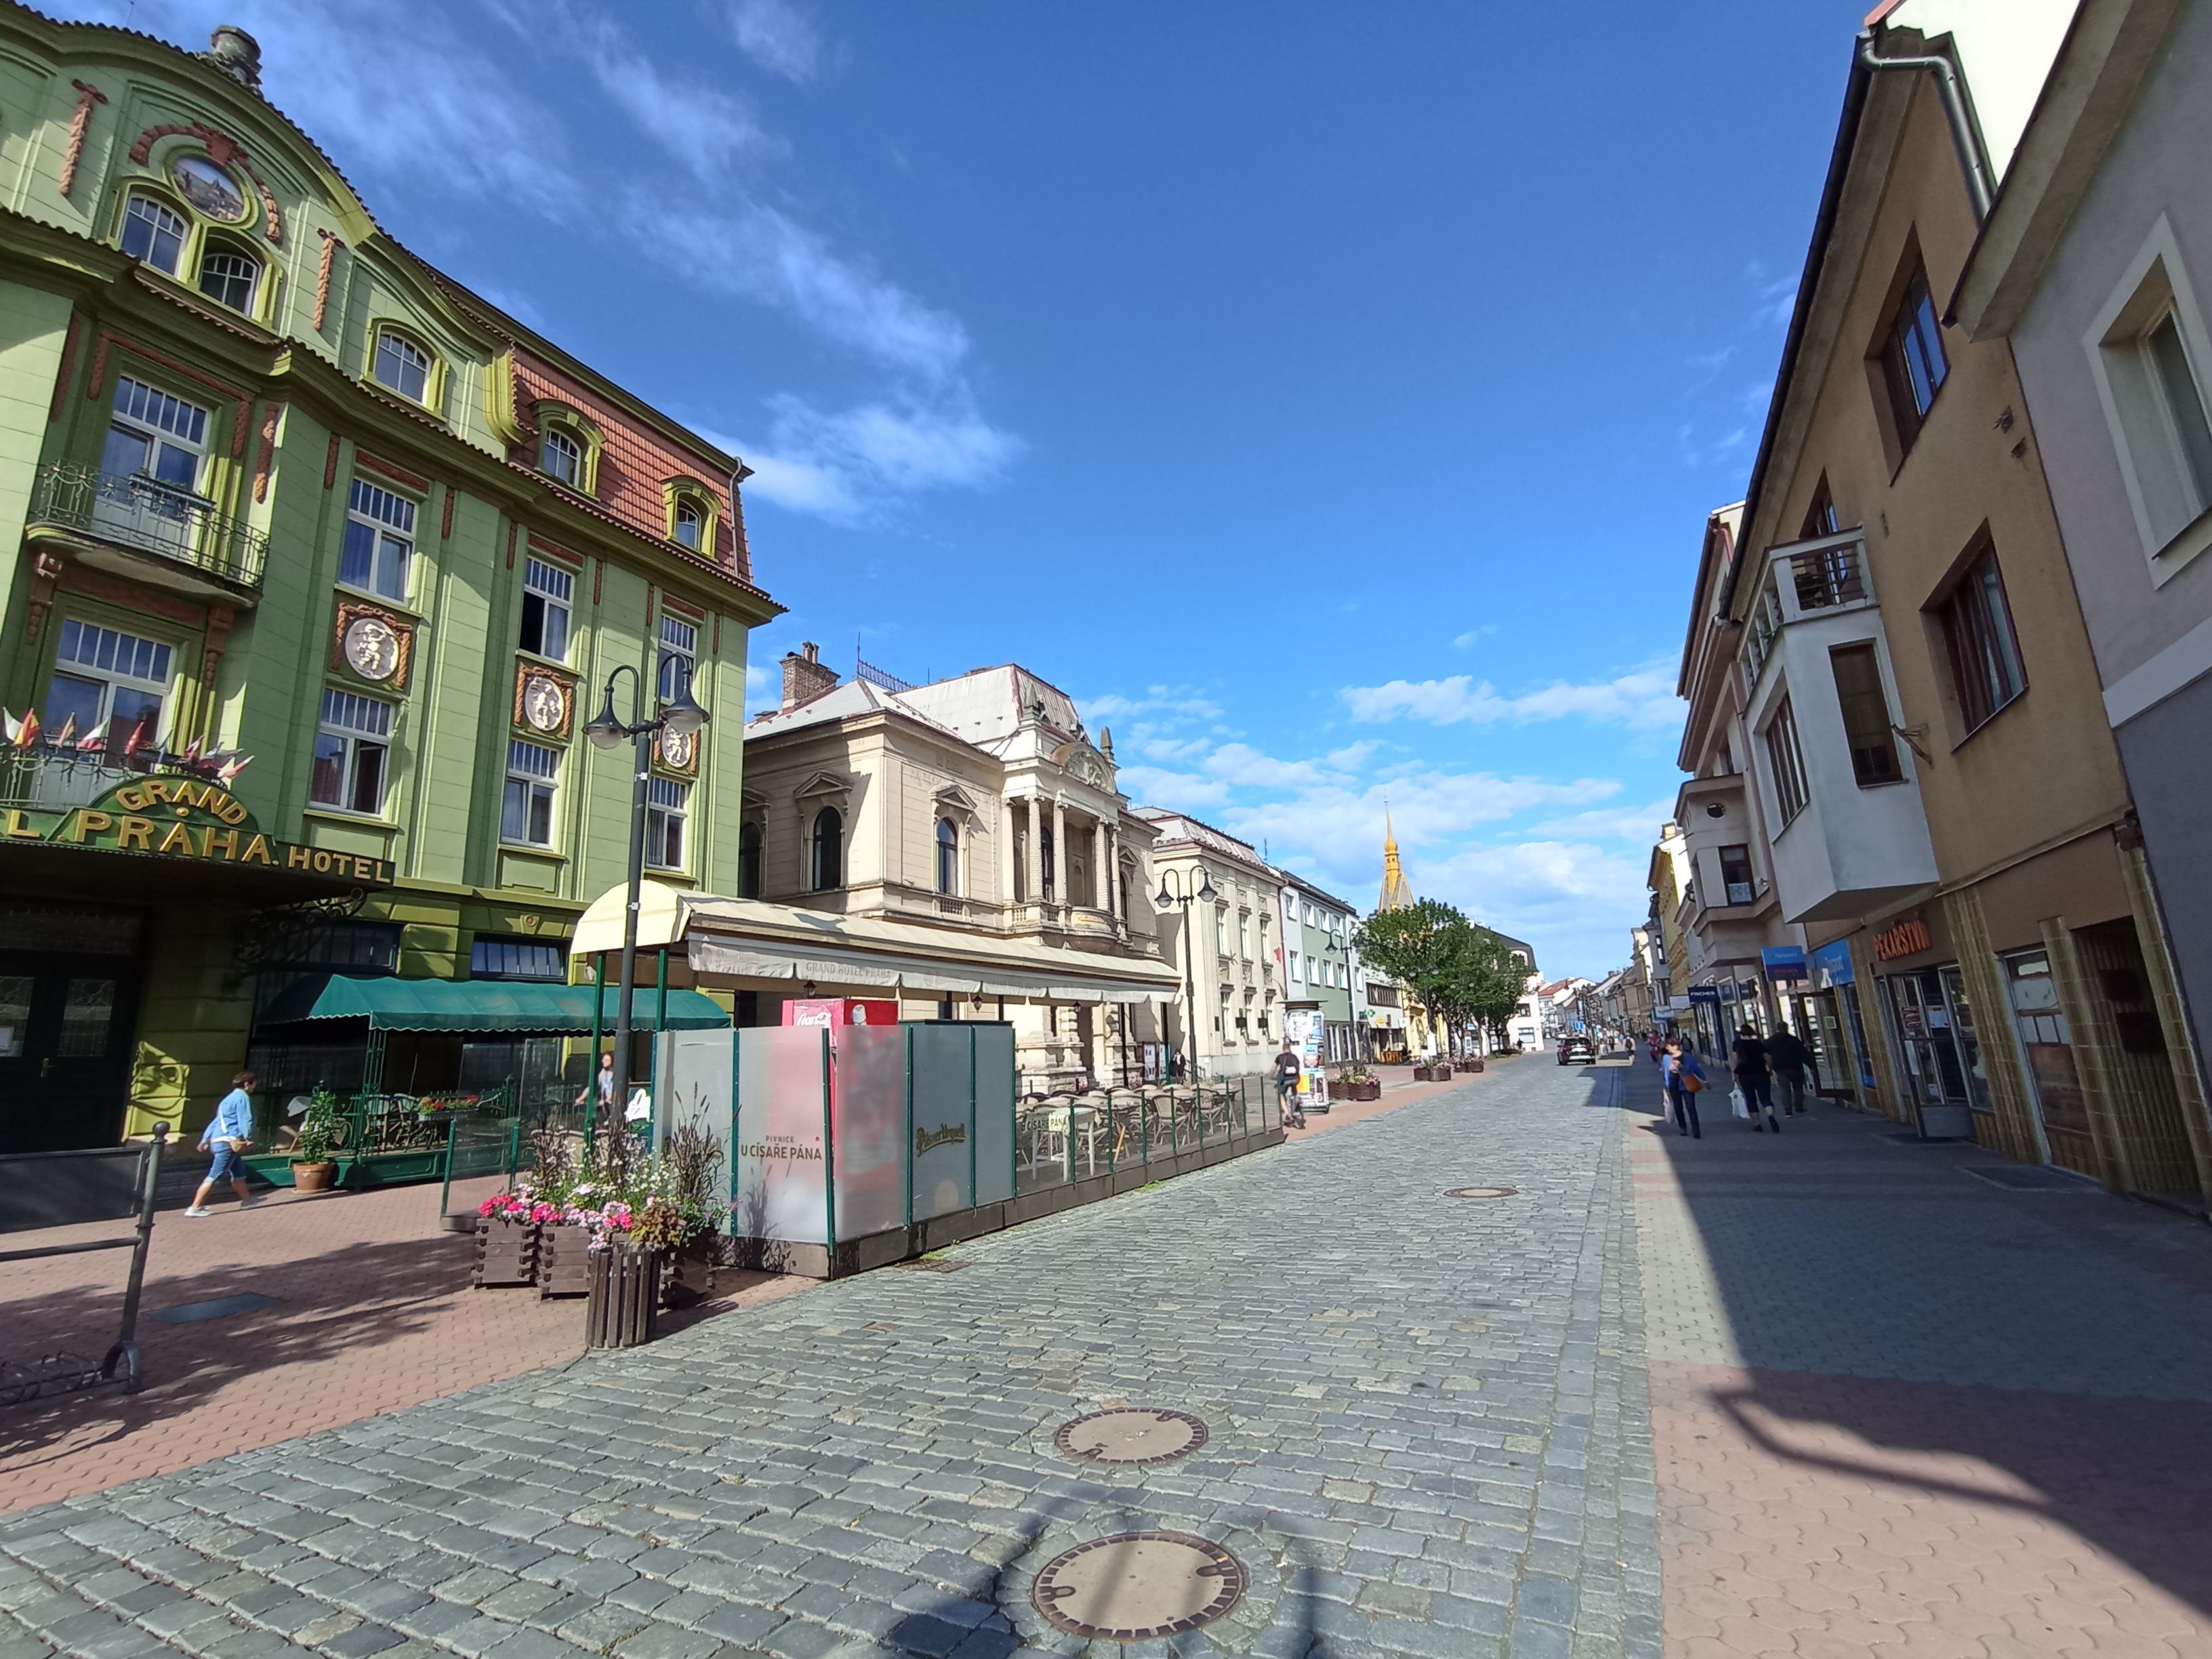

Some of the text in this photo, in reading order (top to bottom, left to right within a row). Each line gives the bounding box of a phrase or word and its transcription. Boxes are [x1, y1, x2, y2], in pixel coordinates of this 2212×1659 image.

[116, 780, 247, 825] GRAND
[74, 810, 270, 865] PRAHA
[288, 846, 390, 883] HOTEL
[806, 962, 891, 979] GRAND HOTEL PRAHA
[765, 1134, 794, 1143] PIVNICE
[741, 1144, 748, 1156] U
[750, 1141, 788, 1159] CÍSAŘE
[790, 1143, 823, 1160] PÁNA
